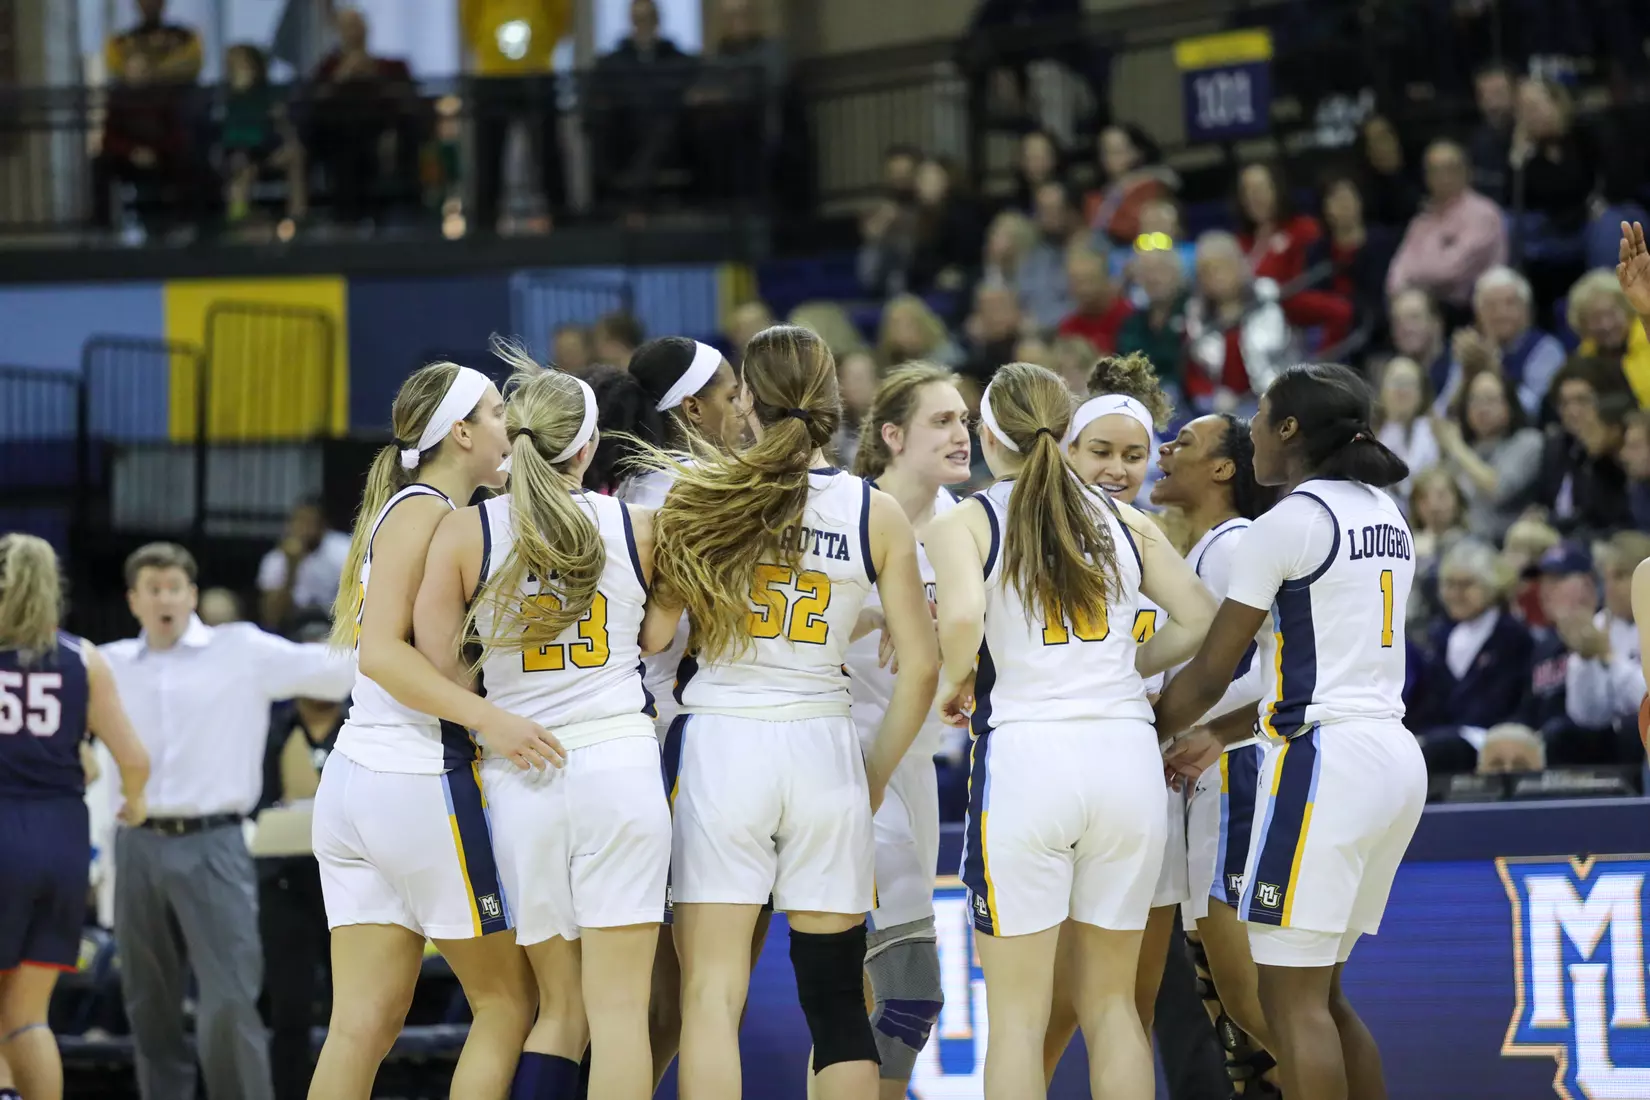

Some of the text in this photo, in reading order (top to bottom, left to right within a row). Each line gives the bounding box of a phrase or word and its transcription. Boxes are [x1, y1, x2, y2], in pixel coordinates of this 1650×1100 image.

[1348, 524, 1410, 561] LOUGBO
[520, 590, 610, 672] 23
[746, 563, 831, 645] 52
[1380, 569, 1393, 648] 1
[0, 670, 62, 737] 55
[480, 894, 501, 917] MU
[1258, 883, 1280, 907] MU
